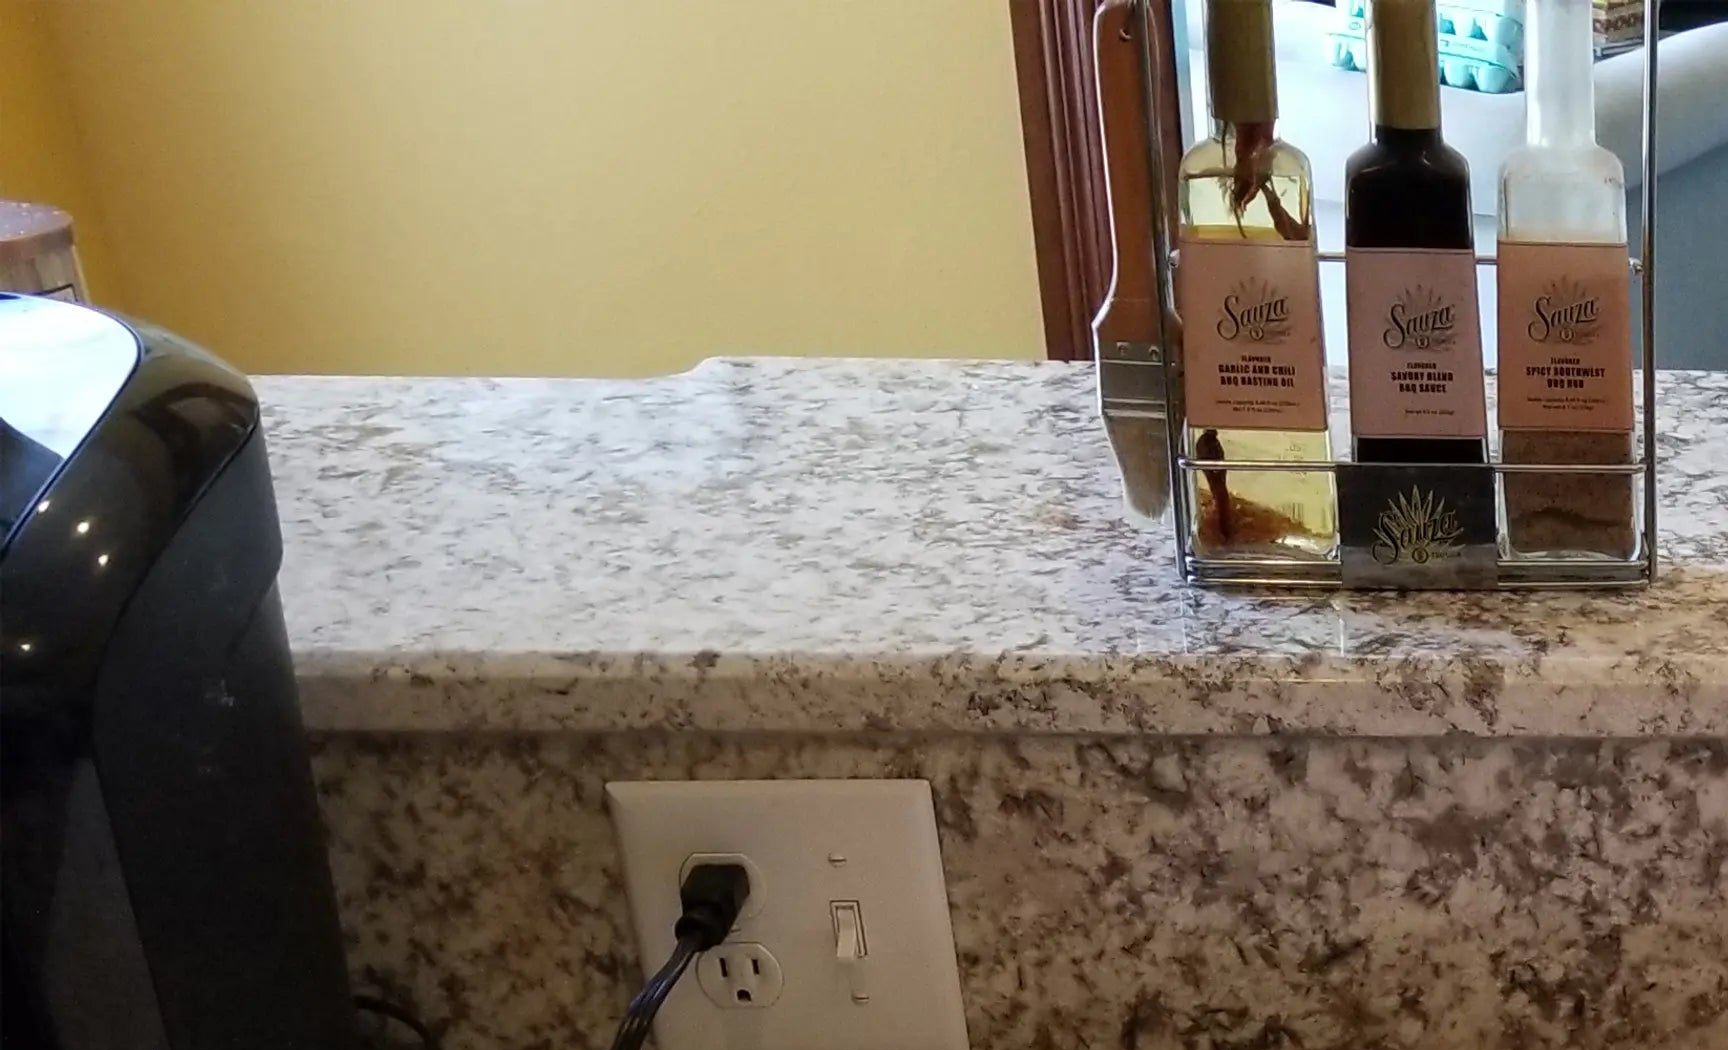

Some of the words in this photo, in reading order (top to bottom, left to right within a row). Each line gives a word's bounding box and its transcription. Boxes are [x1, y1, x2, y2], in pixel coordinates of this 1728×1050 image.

[1217, 295, 1291, 340] Sauza
[1527, 296, 1600, 342] Sauza
[1383, 303, 1456, 349] Sauza
[1218, 364, 1250, 374] GARLIC
[1252, 365, 1270, 374] AND
[1272, 366, 1296, 376] CHILI
[1391, 371, 1424, 381] SAVORY
[1426, 372, 1454, 381] BLEND
[1526, 366, 1551, 376] SPICY
[1553, 367, 1605, 378] SOUTHWEST
[1240, 376, 1279, 387] BASTING
[1281, 378, 1294, 387] OIL
[1399, 383, 1417, 393] BBQ
[1419, 384, 1447, 393] SAUCE
